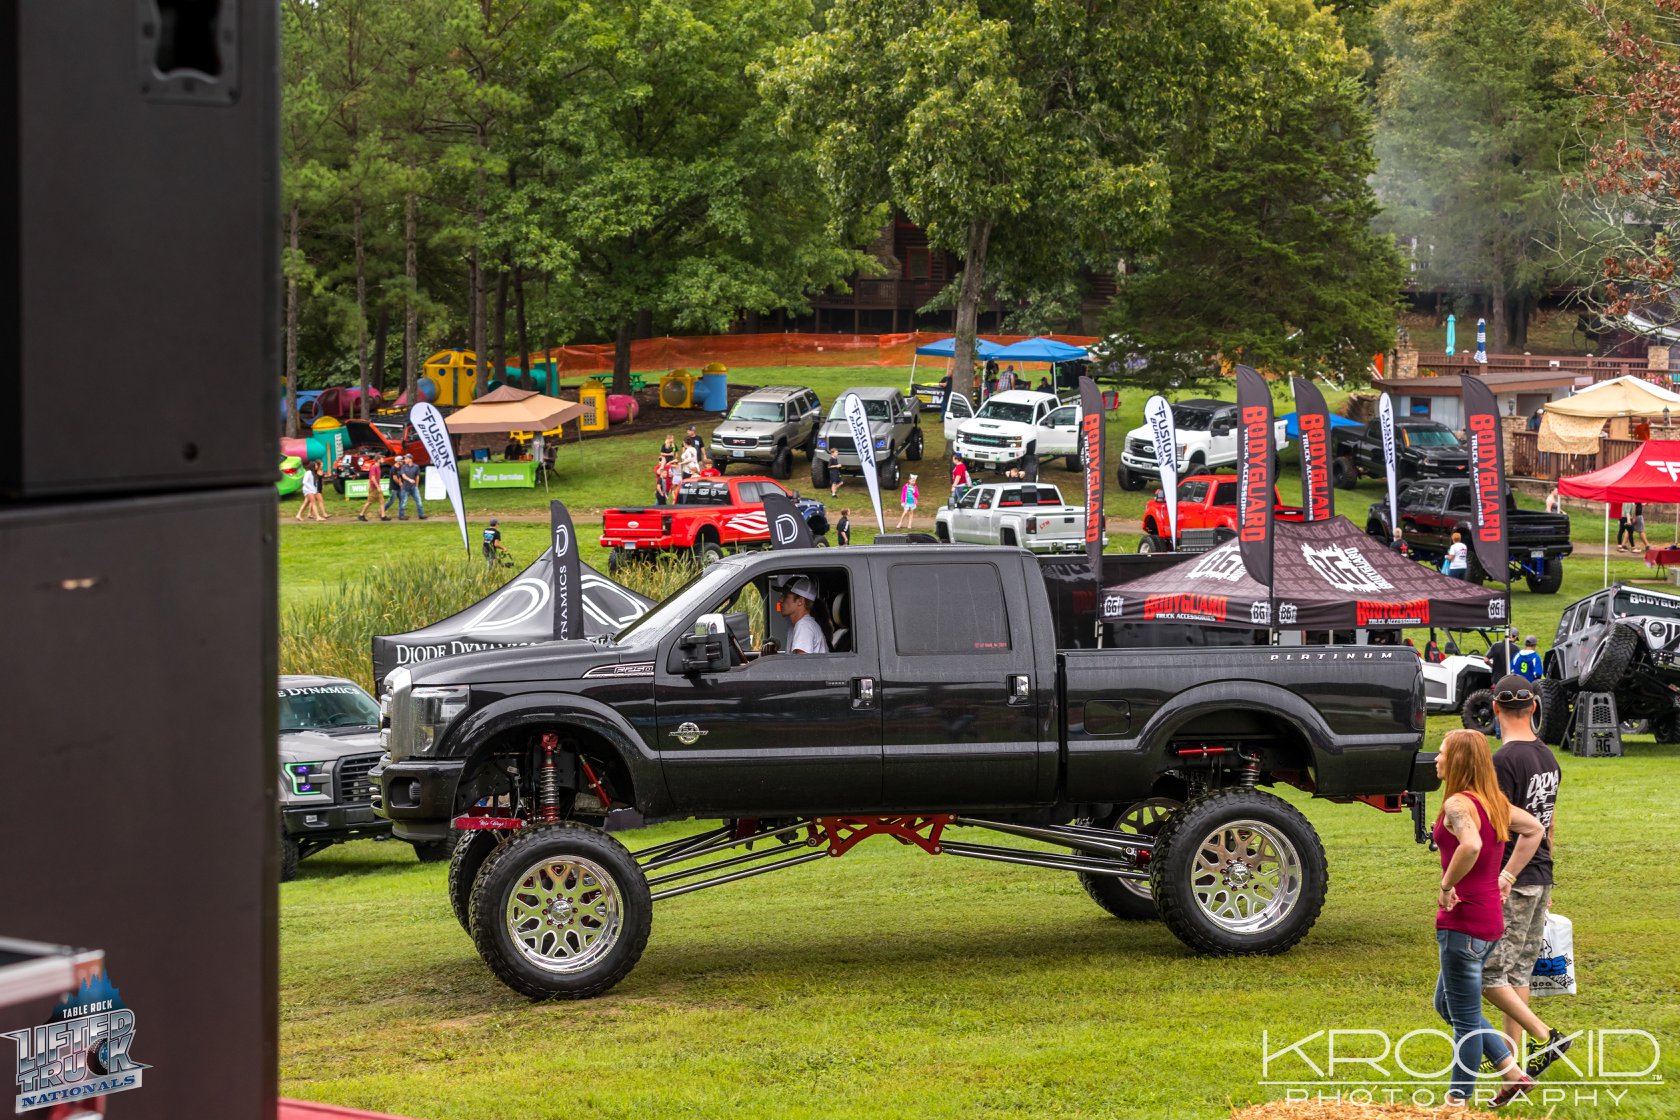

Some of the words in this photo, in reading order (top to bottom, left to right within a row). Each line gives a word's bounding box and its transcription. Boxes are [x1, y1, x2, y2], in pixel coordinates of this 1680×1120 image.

[421, 412, 452, 468] FUSION
[852, 406, 871, 463] FUSION
[1154, 409, 1173, 466] FUSION
[1302, 432, 1311, 461] TRUCK
[1083, 413, 1100, 542] BODYGUARD
[1241, 406, 1267, 542] BODYGUARD
[1300, 413, 1329, 520] BODYGUAR
[1469, 413, 1501, 542] BODYGUARD
[1144, 593, 1228, 622] BODYGUARD
[1356, 599, 1430, 626] BODYGUARD
[396, 644, 446, 664] DIODE
[1270, 652, 1392, 660] PLATINUM
[1521, 661, 1528, 673] 9
[286, 686, 360, 696] DYNAMICS
